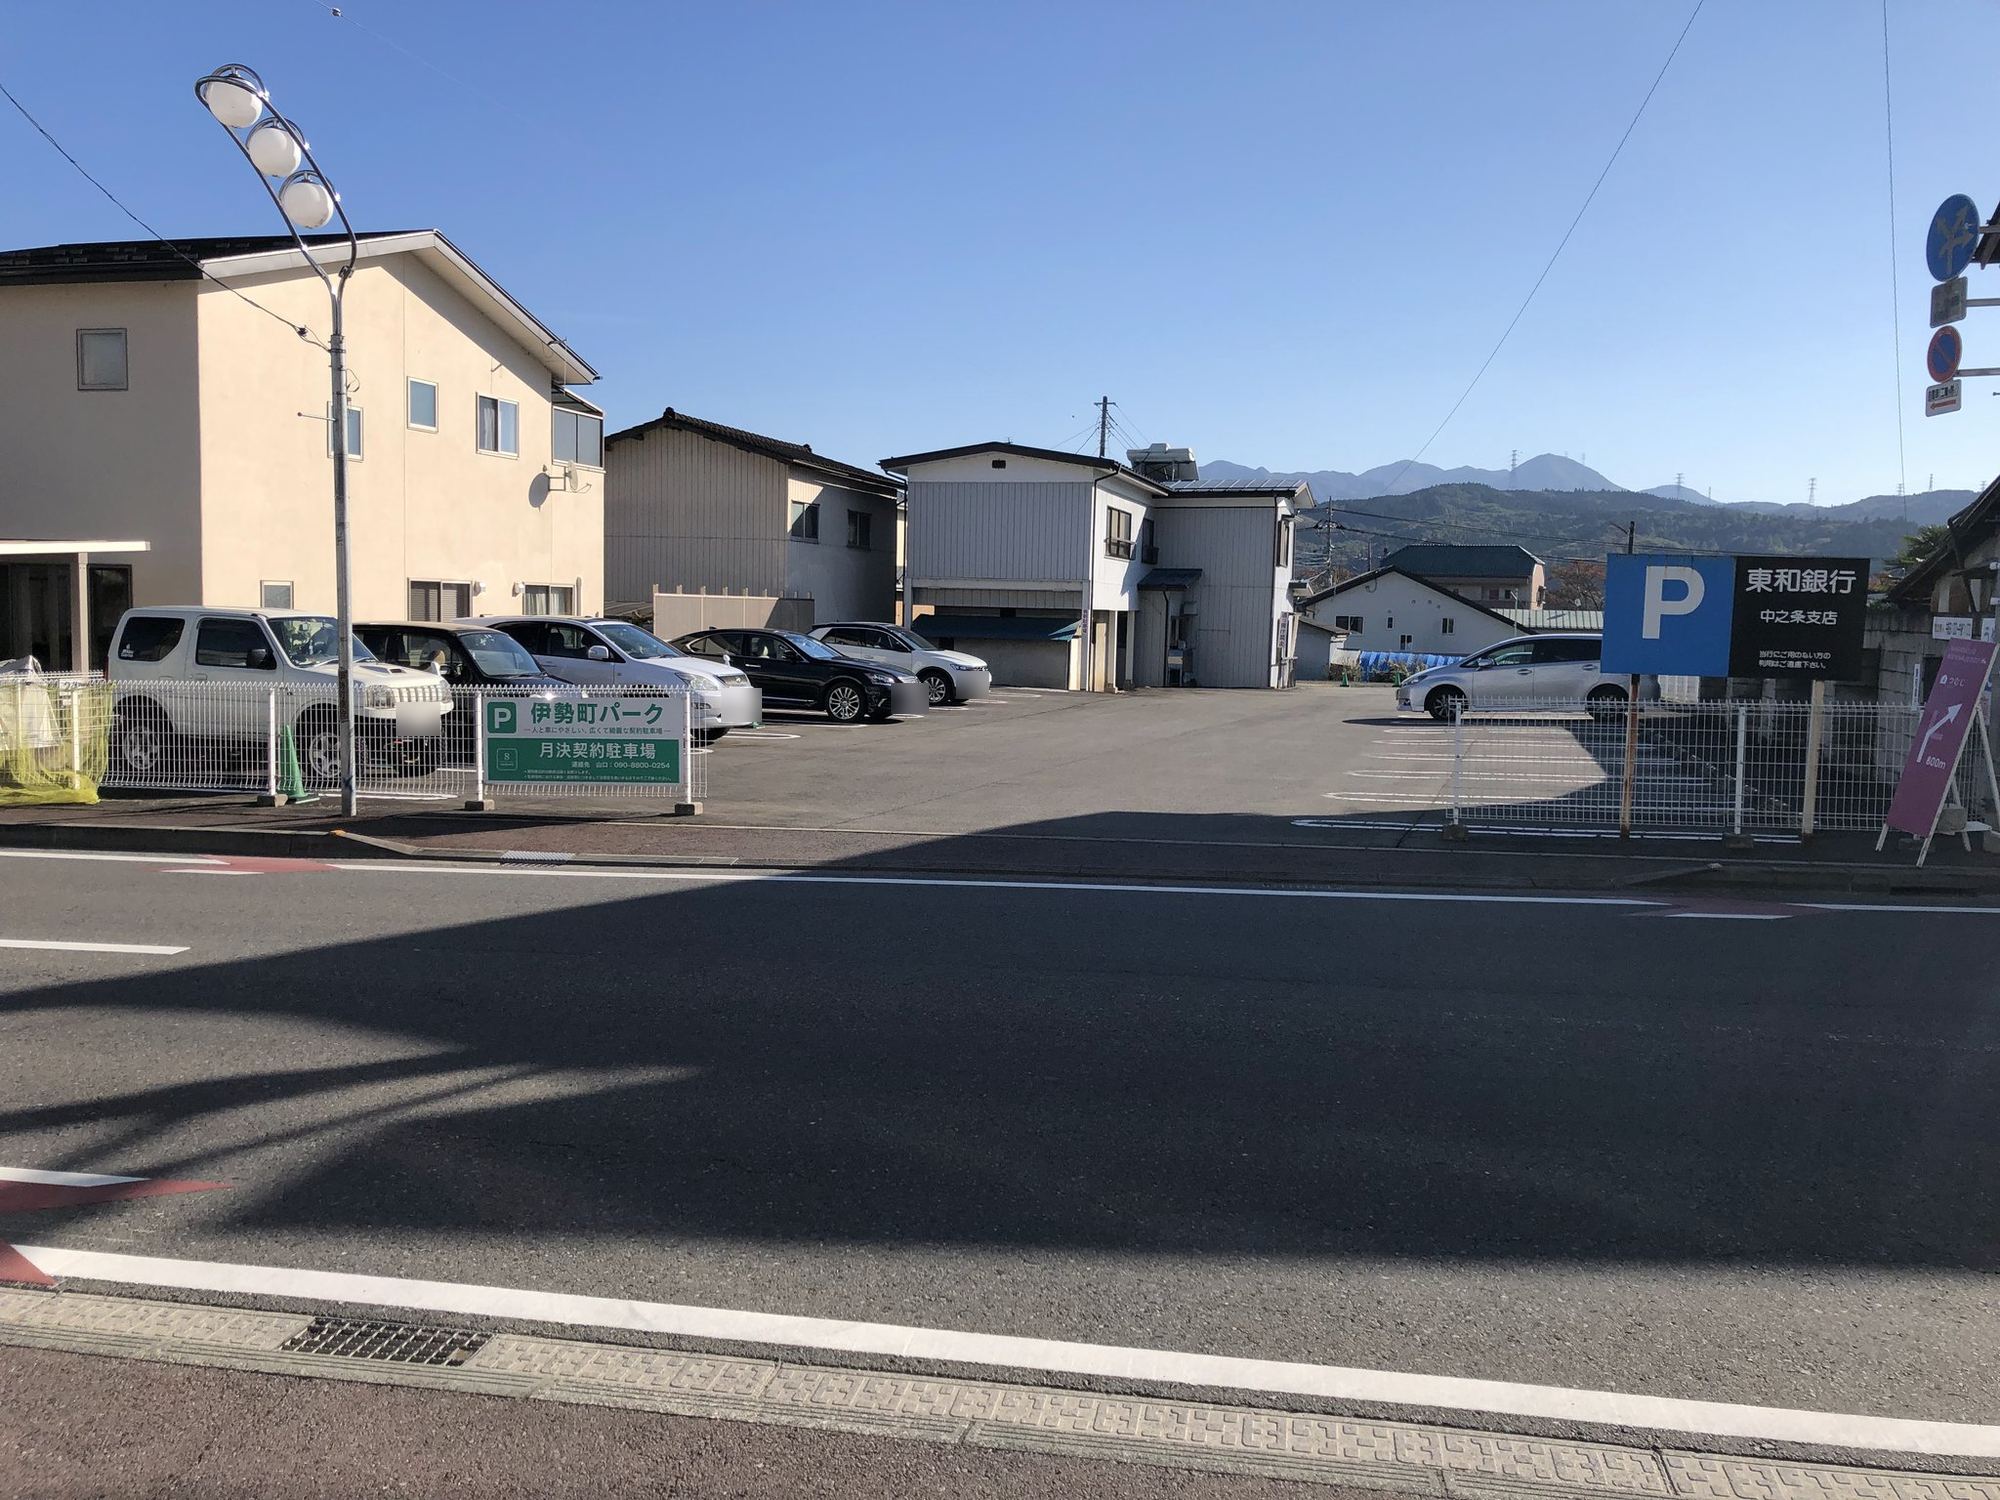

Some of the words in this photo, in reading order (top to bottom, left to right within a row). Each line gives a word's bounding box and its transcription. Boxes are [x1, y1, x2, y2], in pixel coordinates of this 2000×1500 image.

[1745, 567, 1857, 595] 東和銀行
[1642, 565, 1706, 640] P
[1760, 608, 1838, 626] 中之条支店
[1759, 650, 1832, 660] 当行にご用のない方の
[493, 707, 512, 729] P
[530, 701, 664, 725] 伊勢町パーク
[539, 742, 657, 759] 月決契約駐車場
